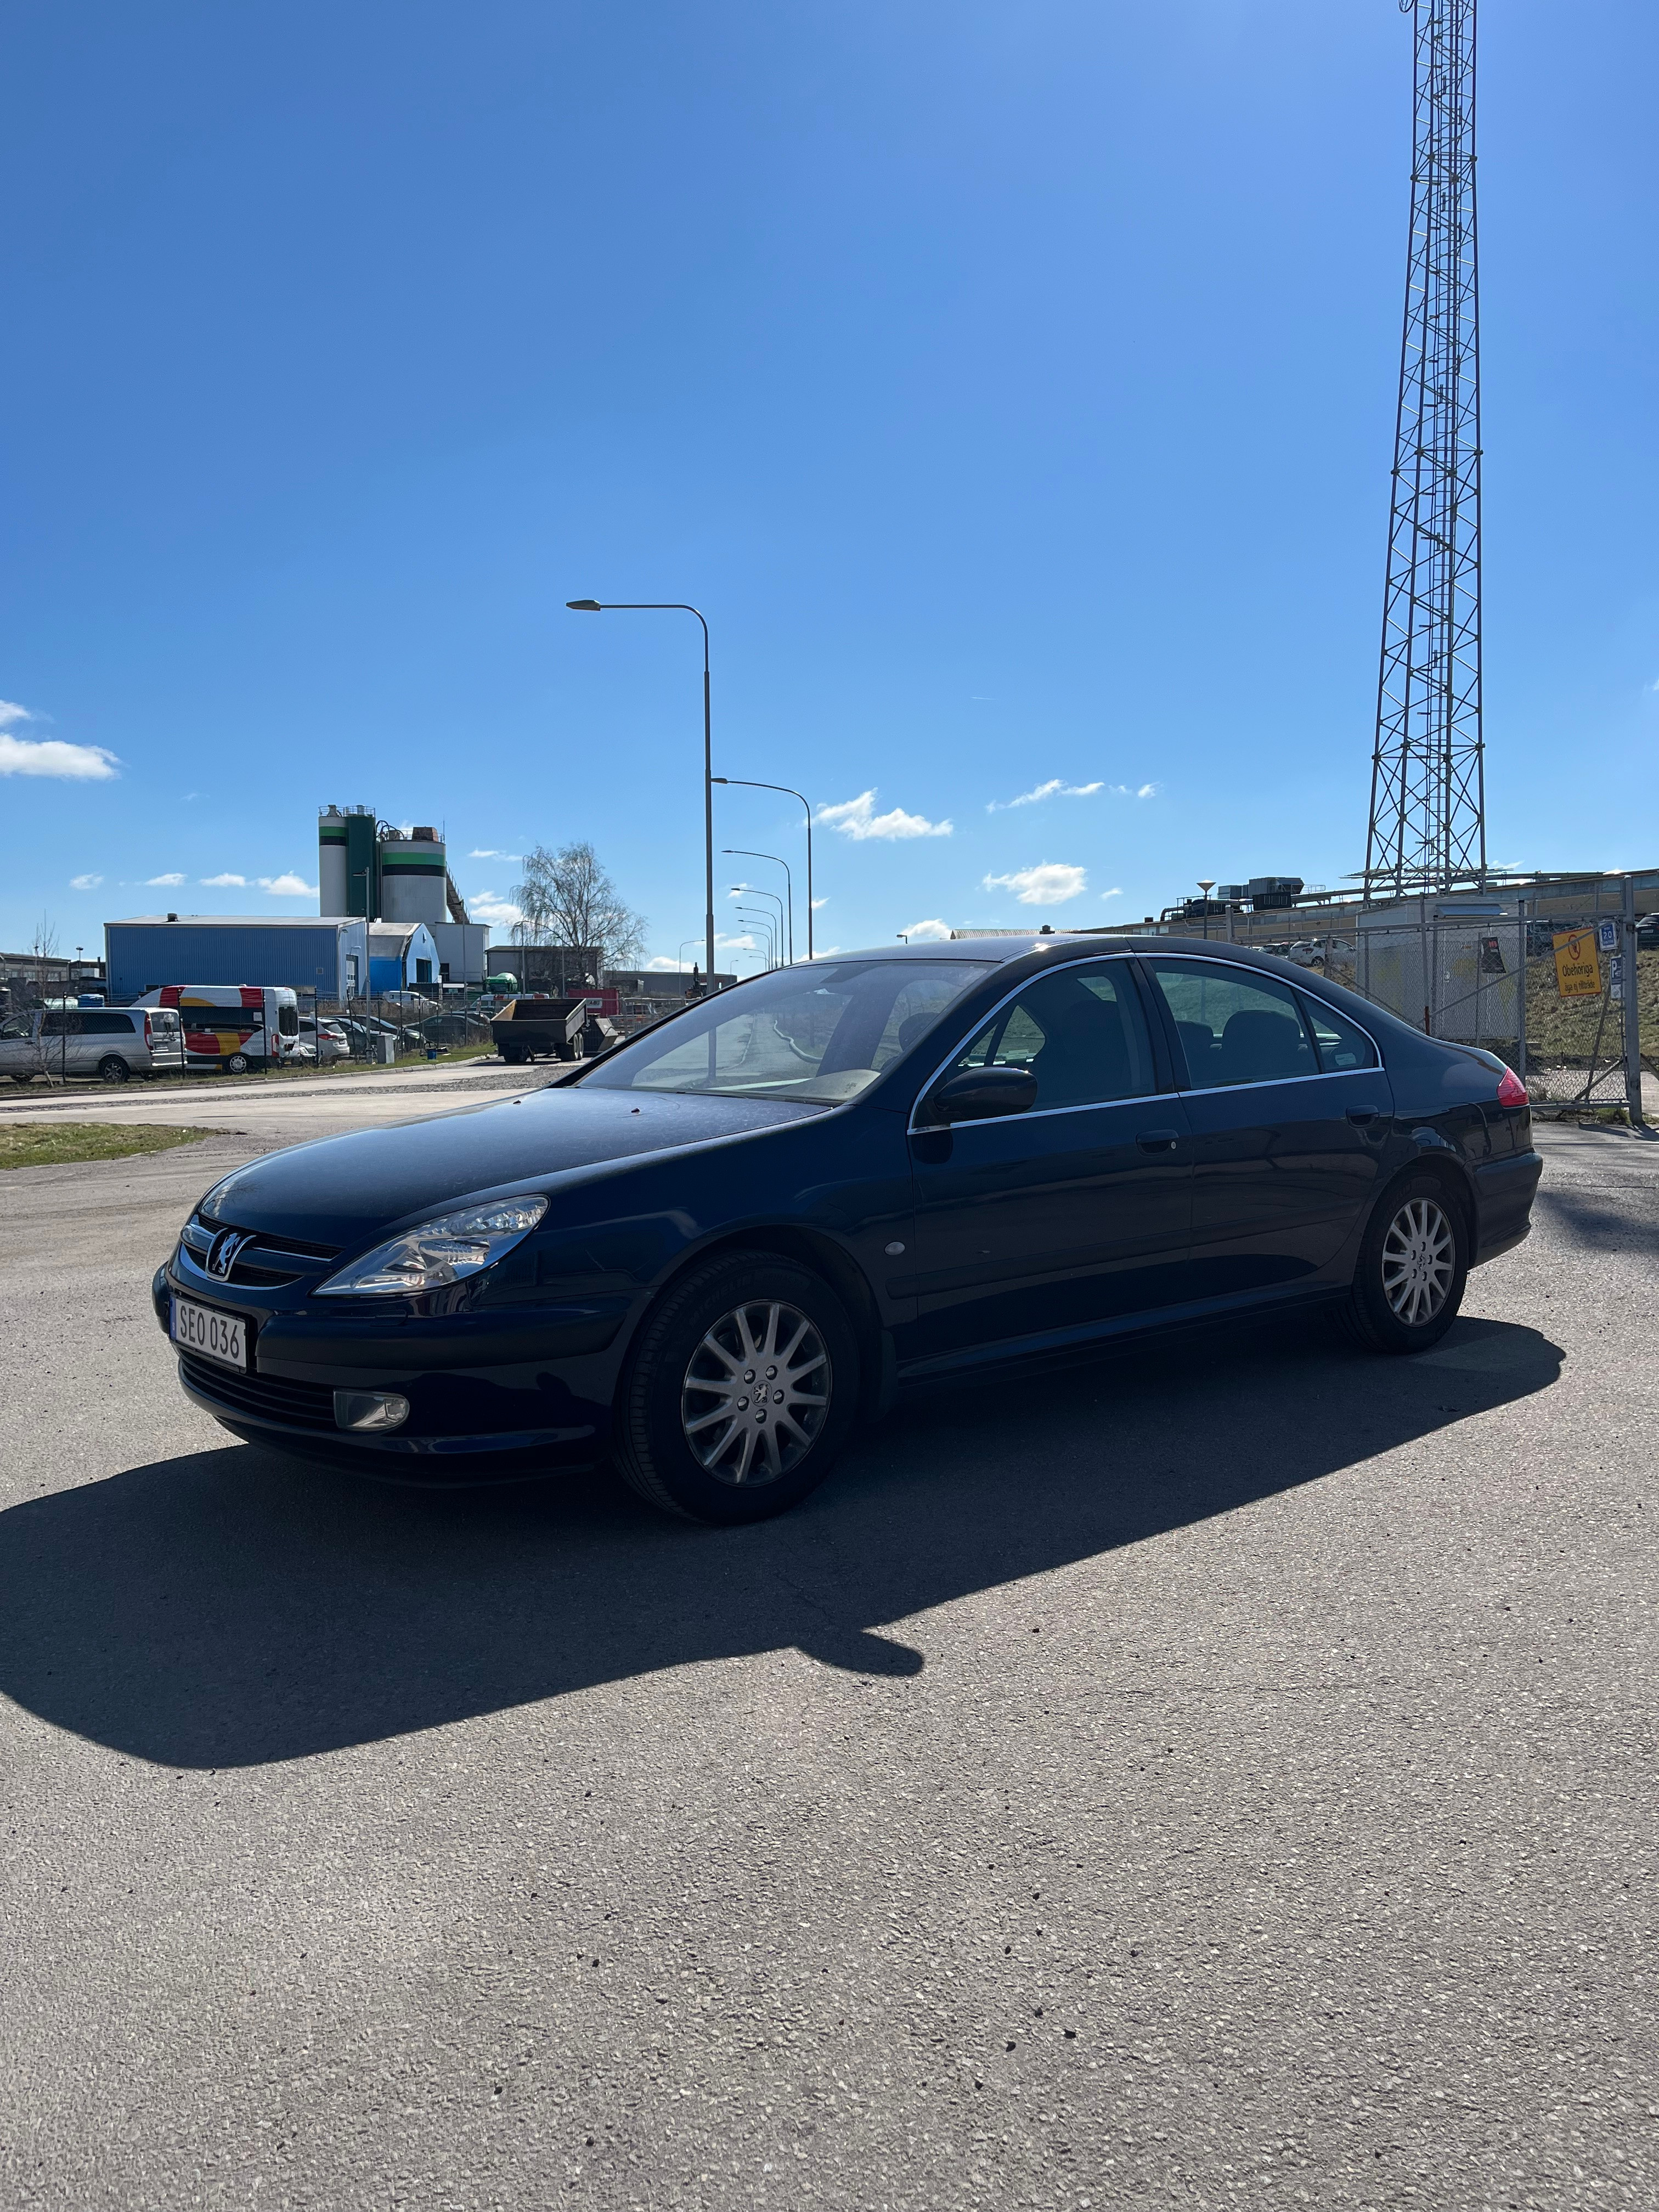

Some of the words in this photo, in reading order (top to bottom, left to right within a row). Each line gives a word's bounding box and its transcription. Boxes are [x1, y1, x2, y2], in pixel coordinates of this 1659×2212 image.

[1603, 931, 1612, 939] 20
[1562, 962, 1593, 977] Obehöriga
[180, 1305, 205, 1346] SEO
[210, 1317, 239, 1359] 036
